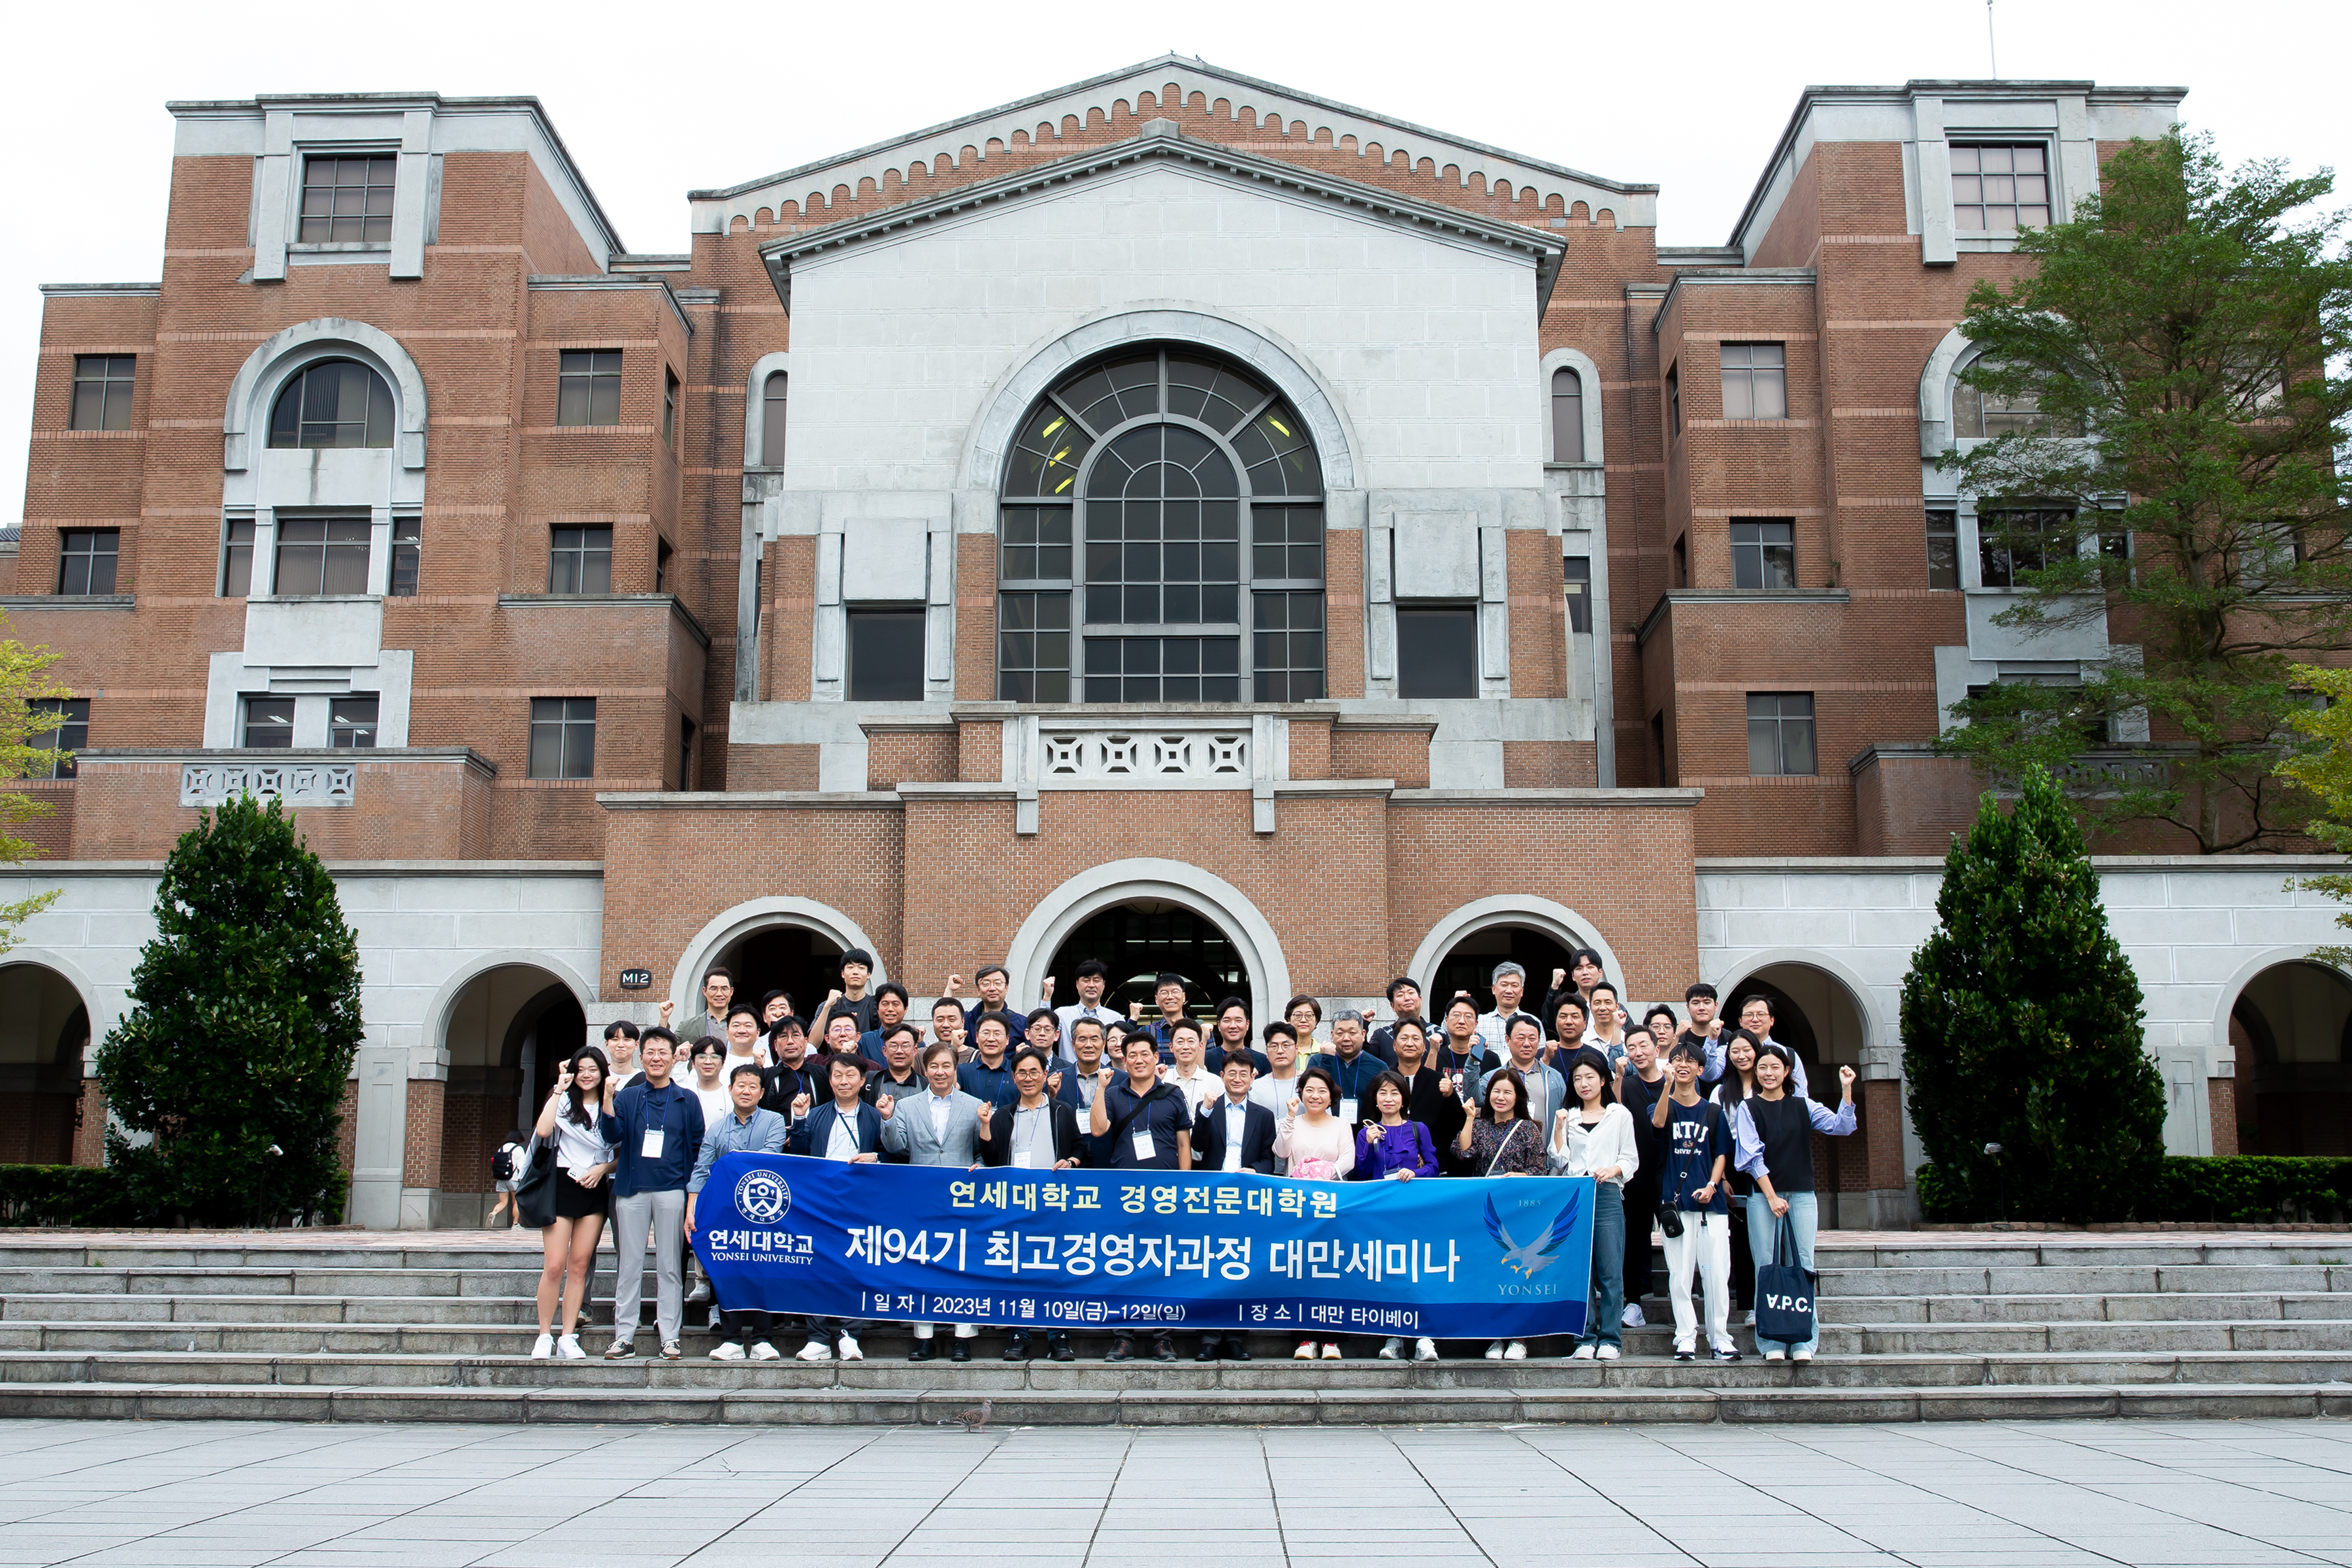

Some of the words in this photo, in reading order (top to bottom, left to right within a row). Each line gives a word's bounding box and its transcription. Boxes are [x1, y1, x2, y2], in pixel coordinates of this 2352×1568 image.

[737, 1173, 755, 1196] YONSEI
[757, 1172, 789, 1200] UNIVERSITY
[949, 1181, 1102, 1212] 연세대학교
[1120, 1185, 1336, 1218] 경영전문대학원
[1518, 1199, 1541, 1207] 1885
[708, 1230, 814, 1254] 연세대학교
[844, 1225, 966, 1271] 제94기
[984, 1231, 1251, 1281] 최고경영자과정
[1269, 1239, 1460, 1283] 대만세미나
[711, 1252, 749, 1262] YONSEI
[752, 1253, 813, 1265] UNIVERSITY
[1497, 1283, 1558, 1296] YONSEI
[933, 1297, 990, 1316] 2023년
[999, 1298, 1036, 1318] 11월
[1311, 1305, 1345, 1324] 대만
[1351, 1307, 1418, 1330] 타이베이
